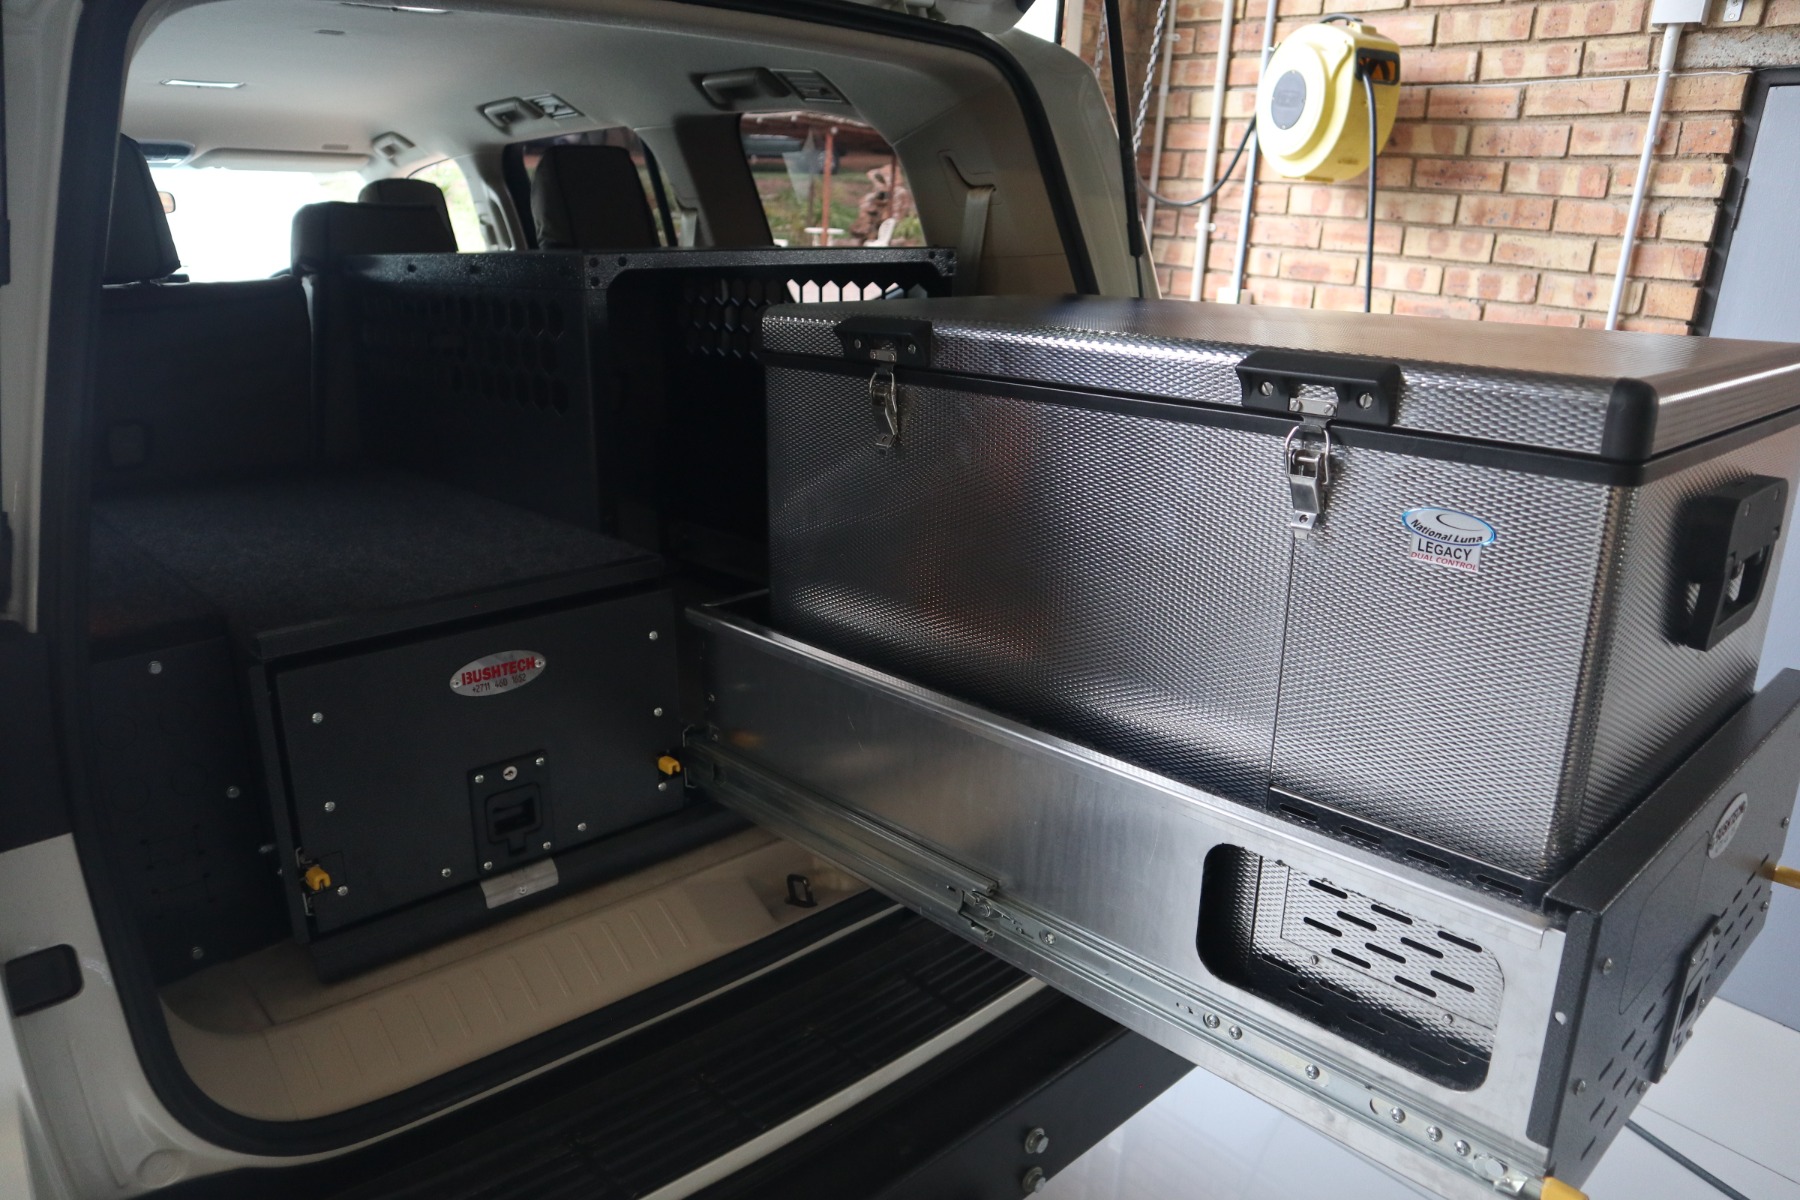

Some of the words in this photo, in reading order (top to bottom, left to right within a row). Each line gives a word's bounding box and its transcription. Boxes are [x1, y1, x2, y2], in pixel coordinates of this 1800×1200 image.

[1410, 519, 1453, 541] National
[1454, 535, 1483, 544] Luna
[1410, 551, 1434, 561] DUAL
[1436, 556, 1477, 571] CONTROL
[1417, 538, 1473, 561] LEGACY
[461, 656, 535, 685] BUSHTECH
